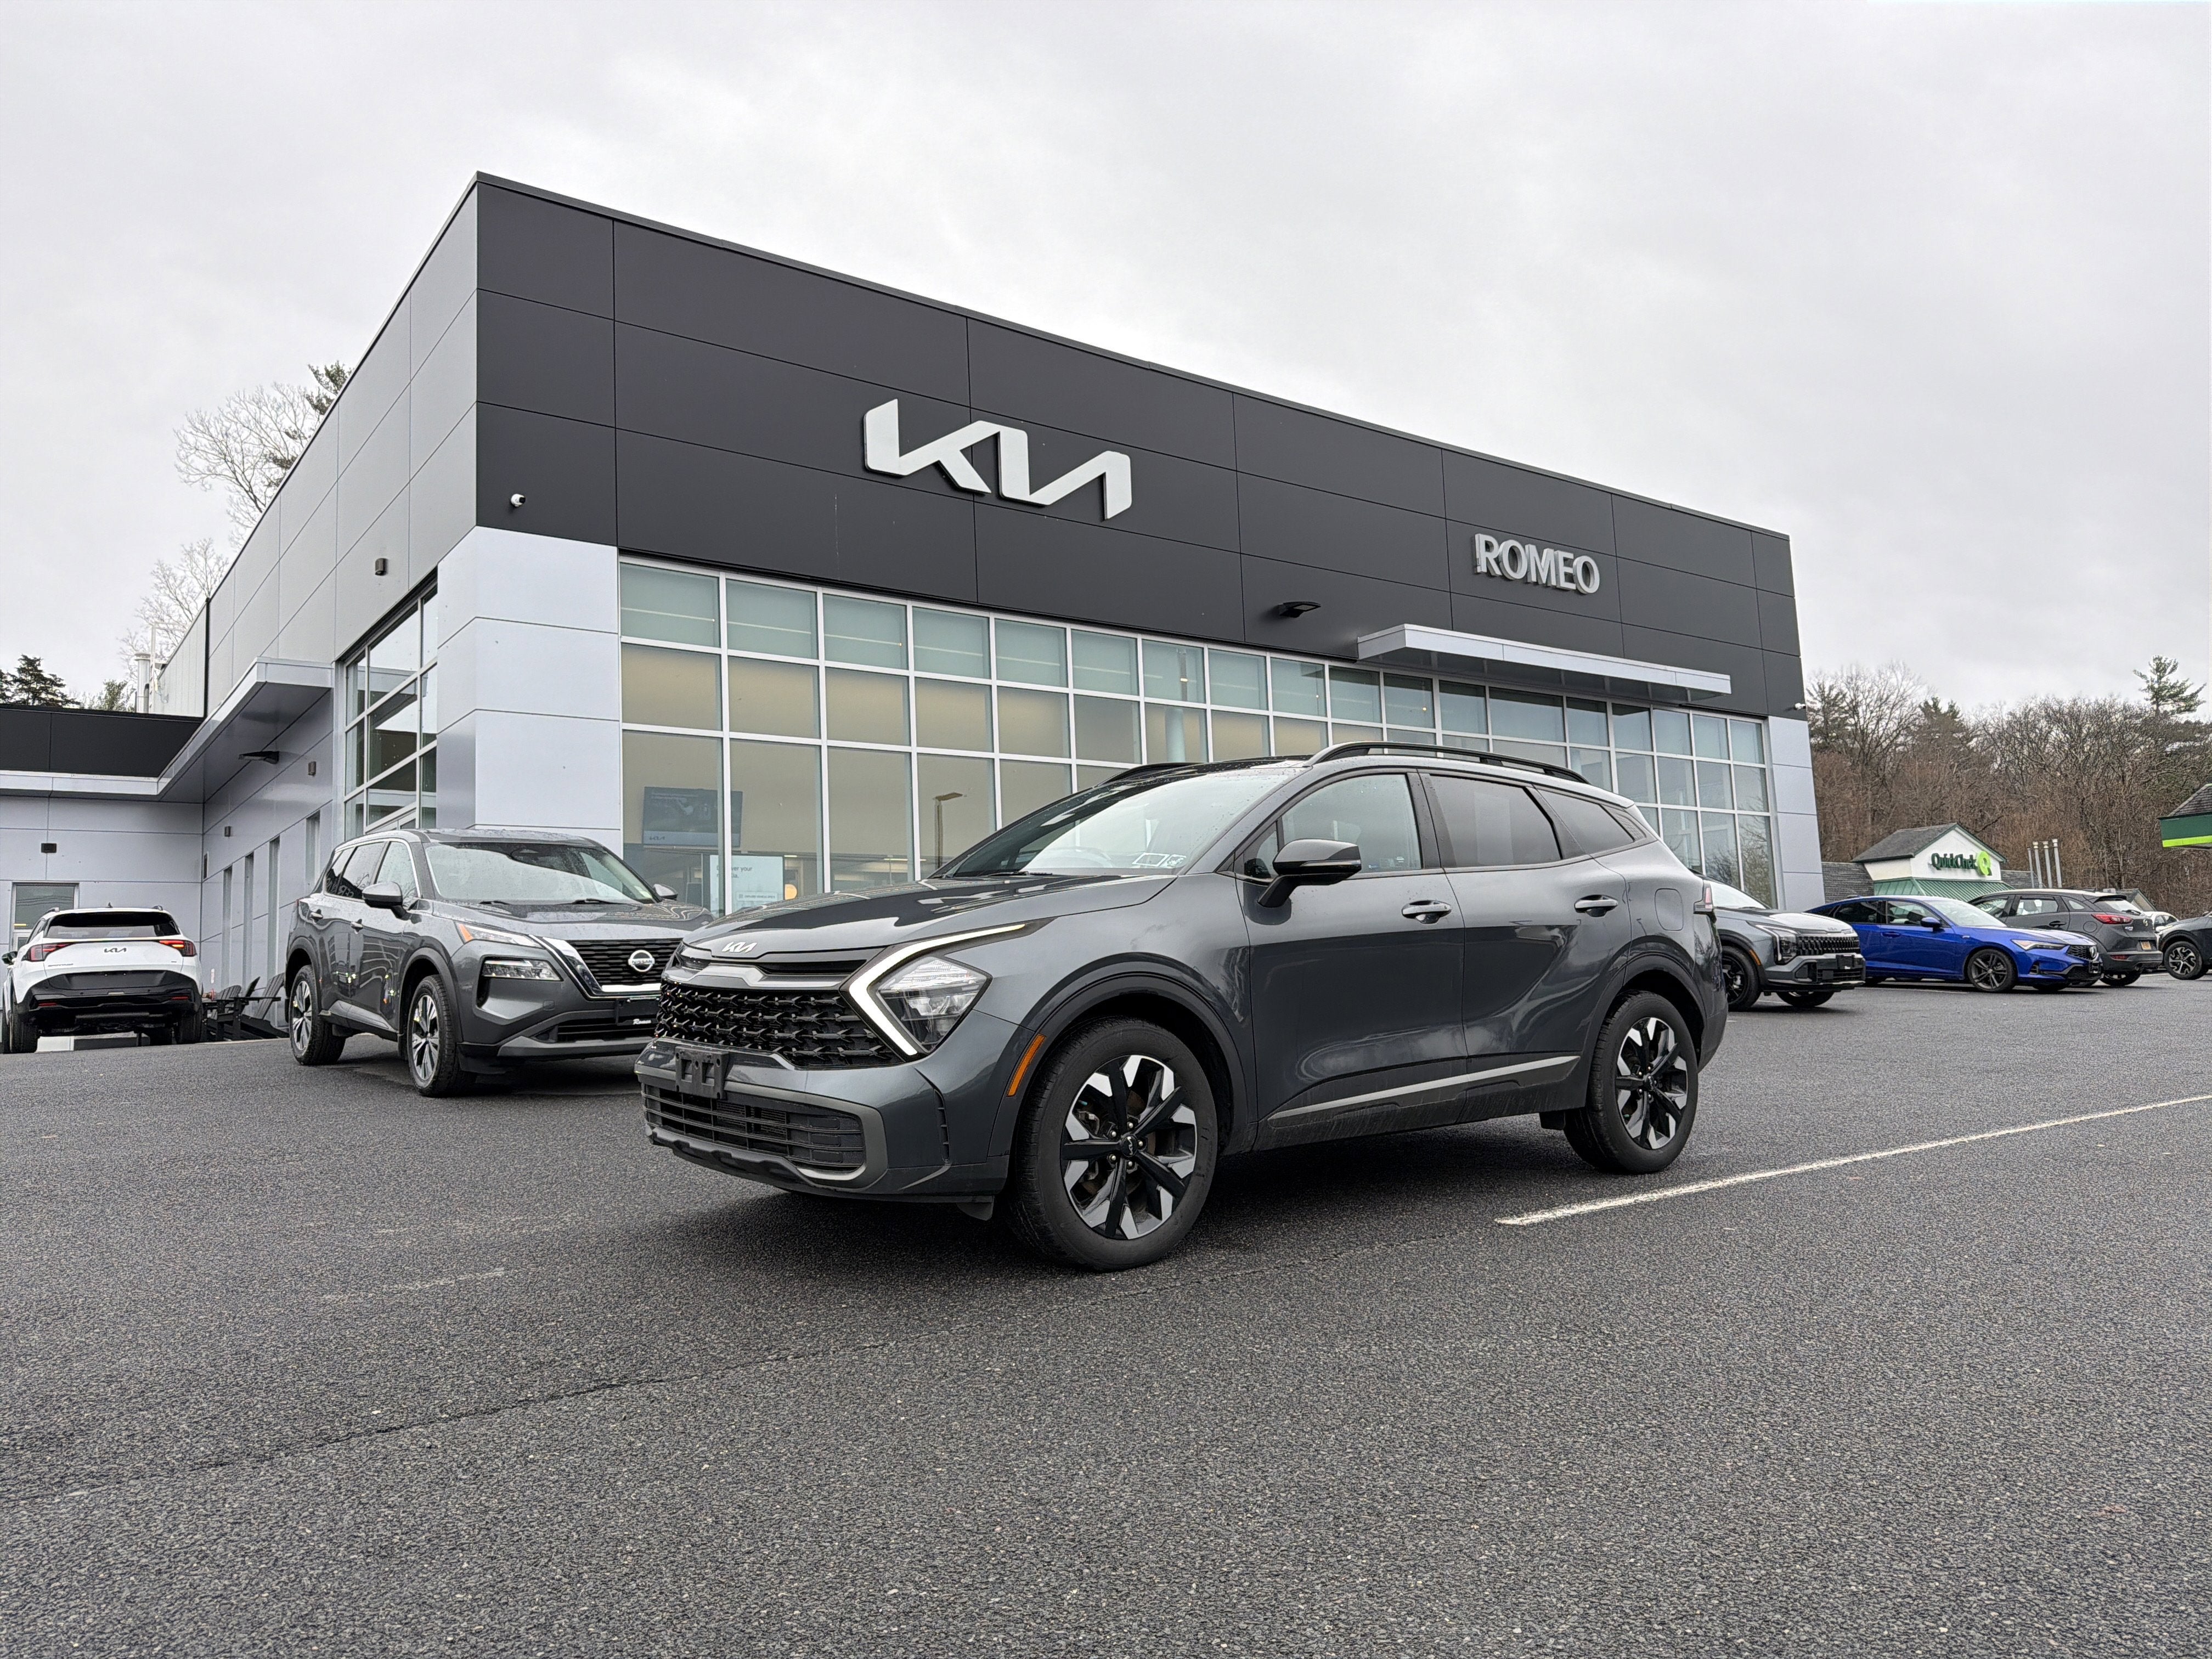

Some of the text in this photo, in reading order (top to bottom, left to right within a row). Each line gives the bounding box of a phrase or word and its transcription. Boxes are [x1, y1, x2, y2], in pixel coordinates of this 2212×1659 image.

[864, 398, 1132, 520] KIA
[1475, 533, 1600, 594] ROMEO
[721, 941, 758, 953] KIA
